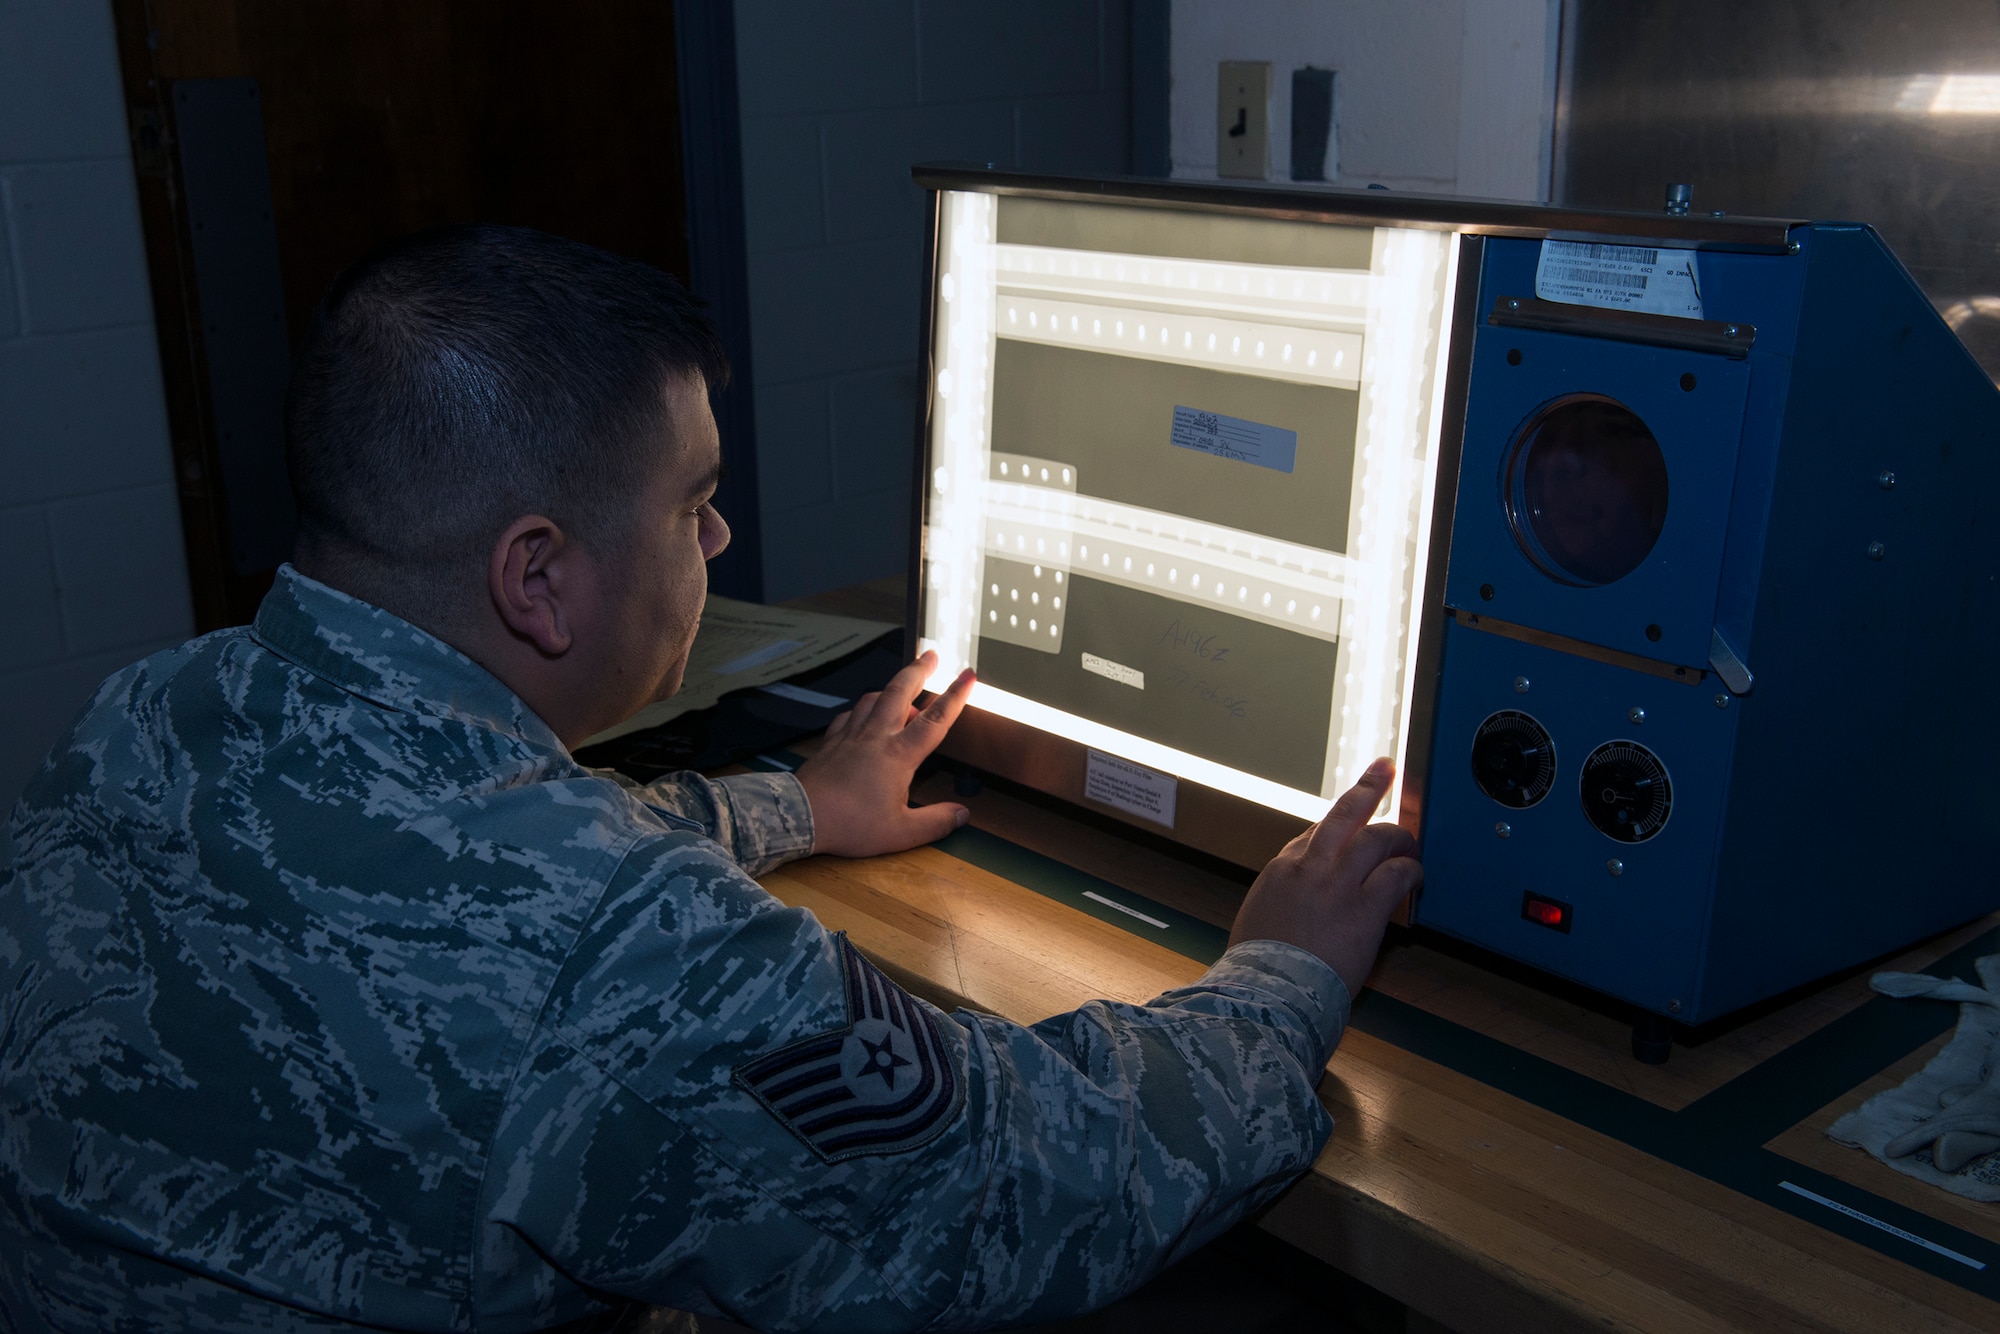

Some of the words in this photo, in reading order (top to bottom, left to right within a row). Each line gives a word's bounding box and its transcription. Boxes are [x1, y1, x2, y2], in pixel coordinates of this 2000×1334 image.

[1828, 1201, 1848, 1212] FILM
[1848, 1210, 1891, 1230] HANDLING
[1891, 1228, 1926, 1245] GLOVES
